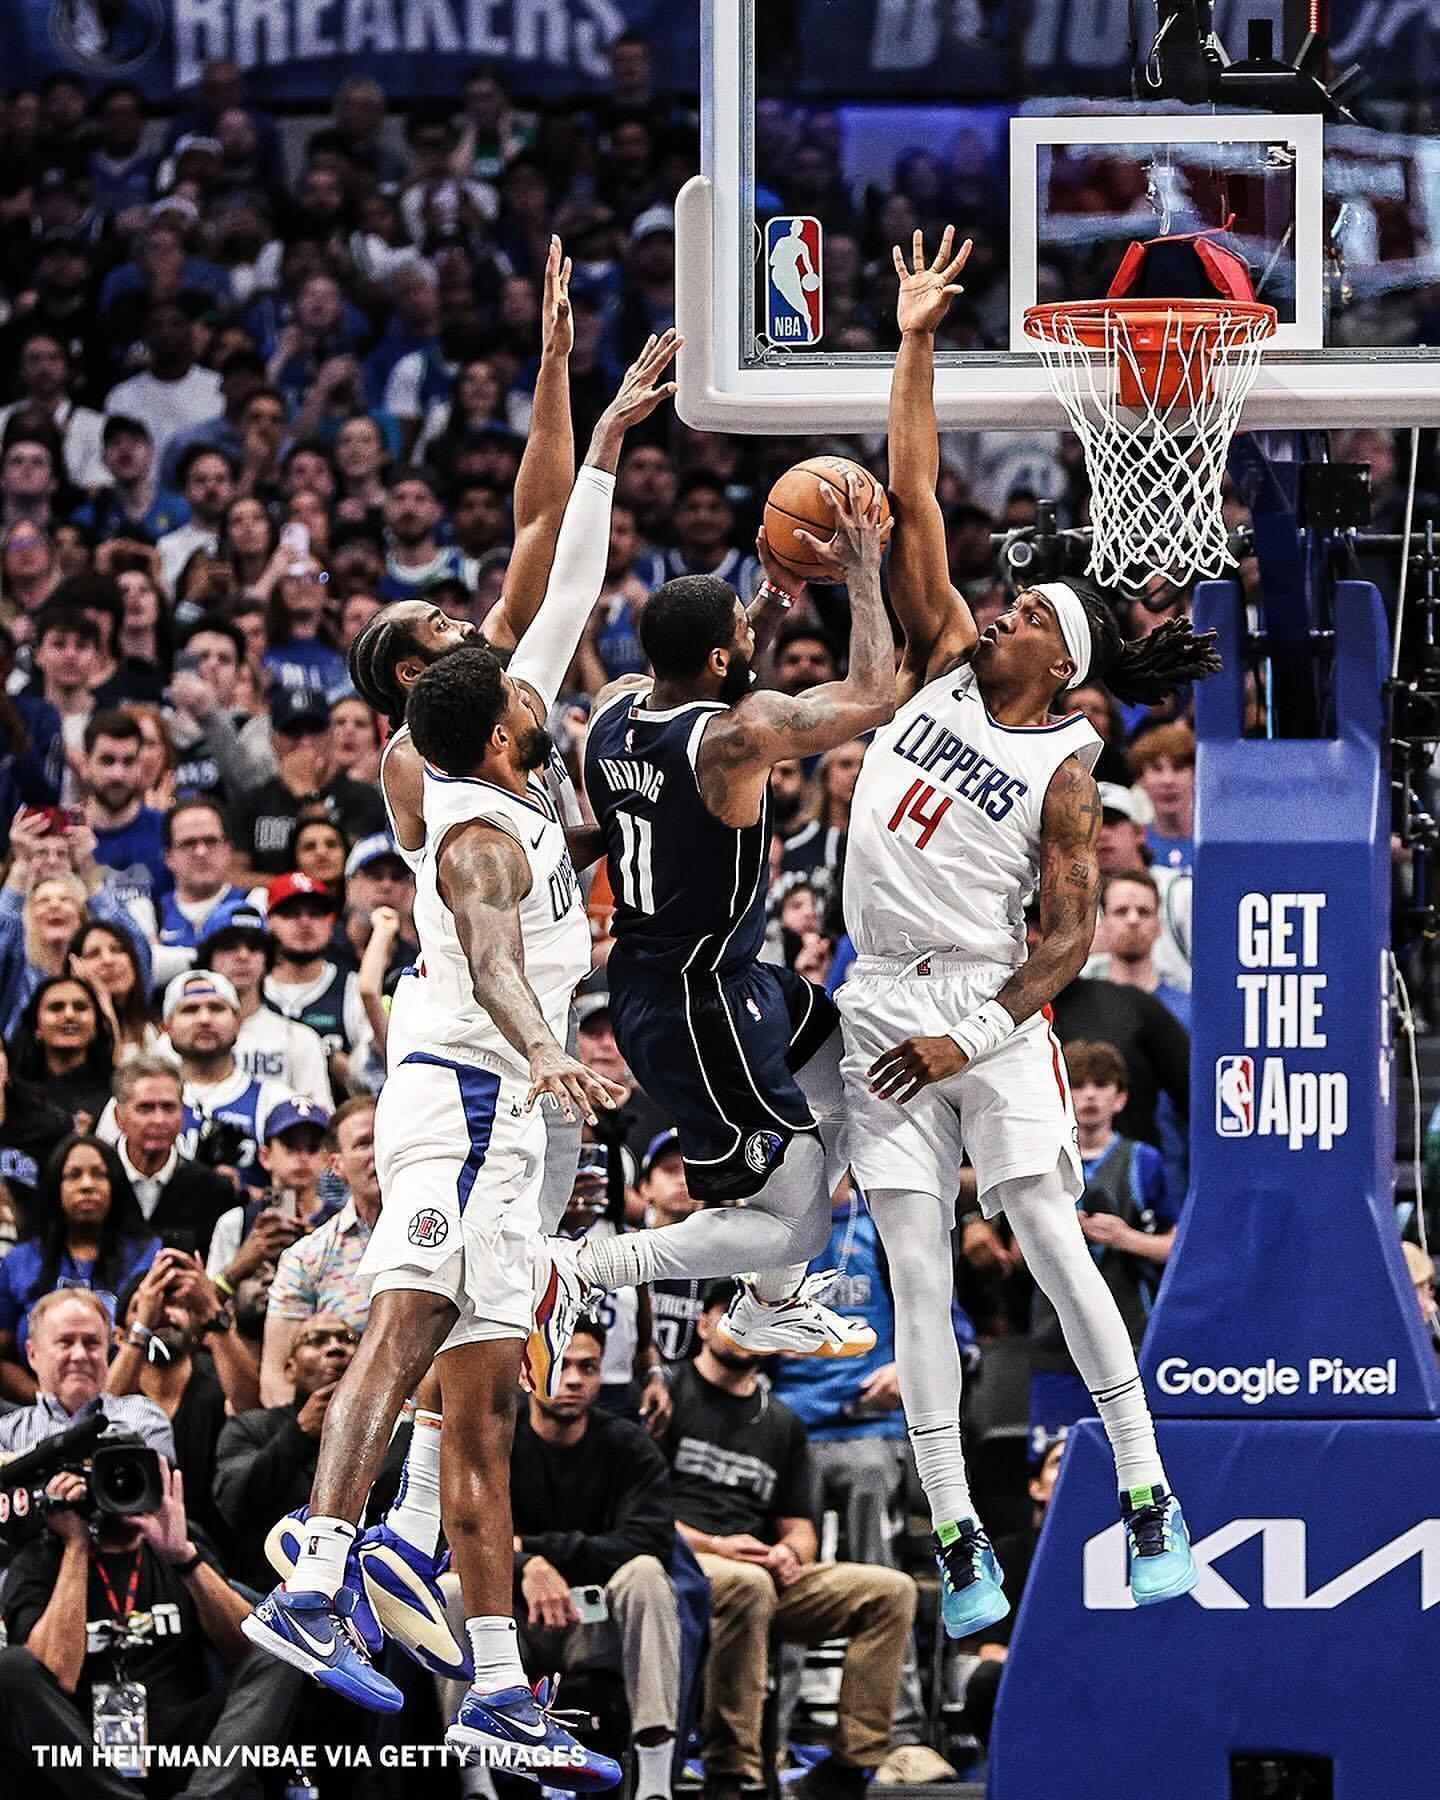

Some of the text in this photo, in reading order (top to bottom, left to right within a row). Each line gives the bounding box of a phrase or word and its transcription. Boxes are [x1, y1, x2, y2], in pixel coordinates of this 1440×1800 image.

[774, 316, 802, 337] NBA
[598, 758, 665, 803] IRVING
[893, 712, 1028, 822] CLIPPERS
[887, 778, 953, 850] 14
[615, 809, 655, 916] 11
[1238, 892, 1326, 967] GET
[1236, 974, 1327, 1048] THE
[1257, 1057, 1348, 1150] App
[1156, 1357, 1397, 1404] Google Pixel
[674, 1437, 777, 1501] ESPN
